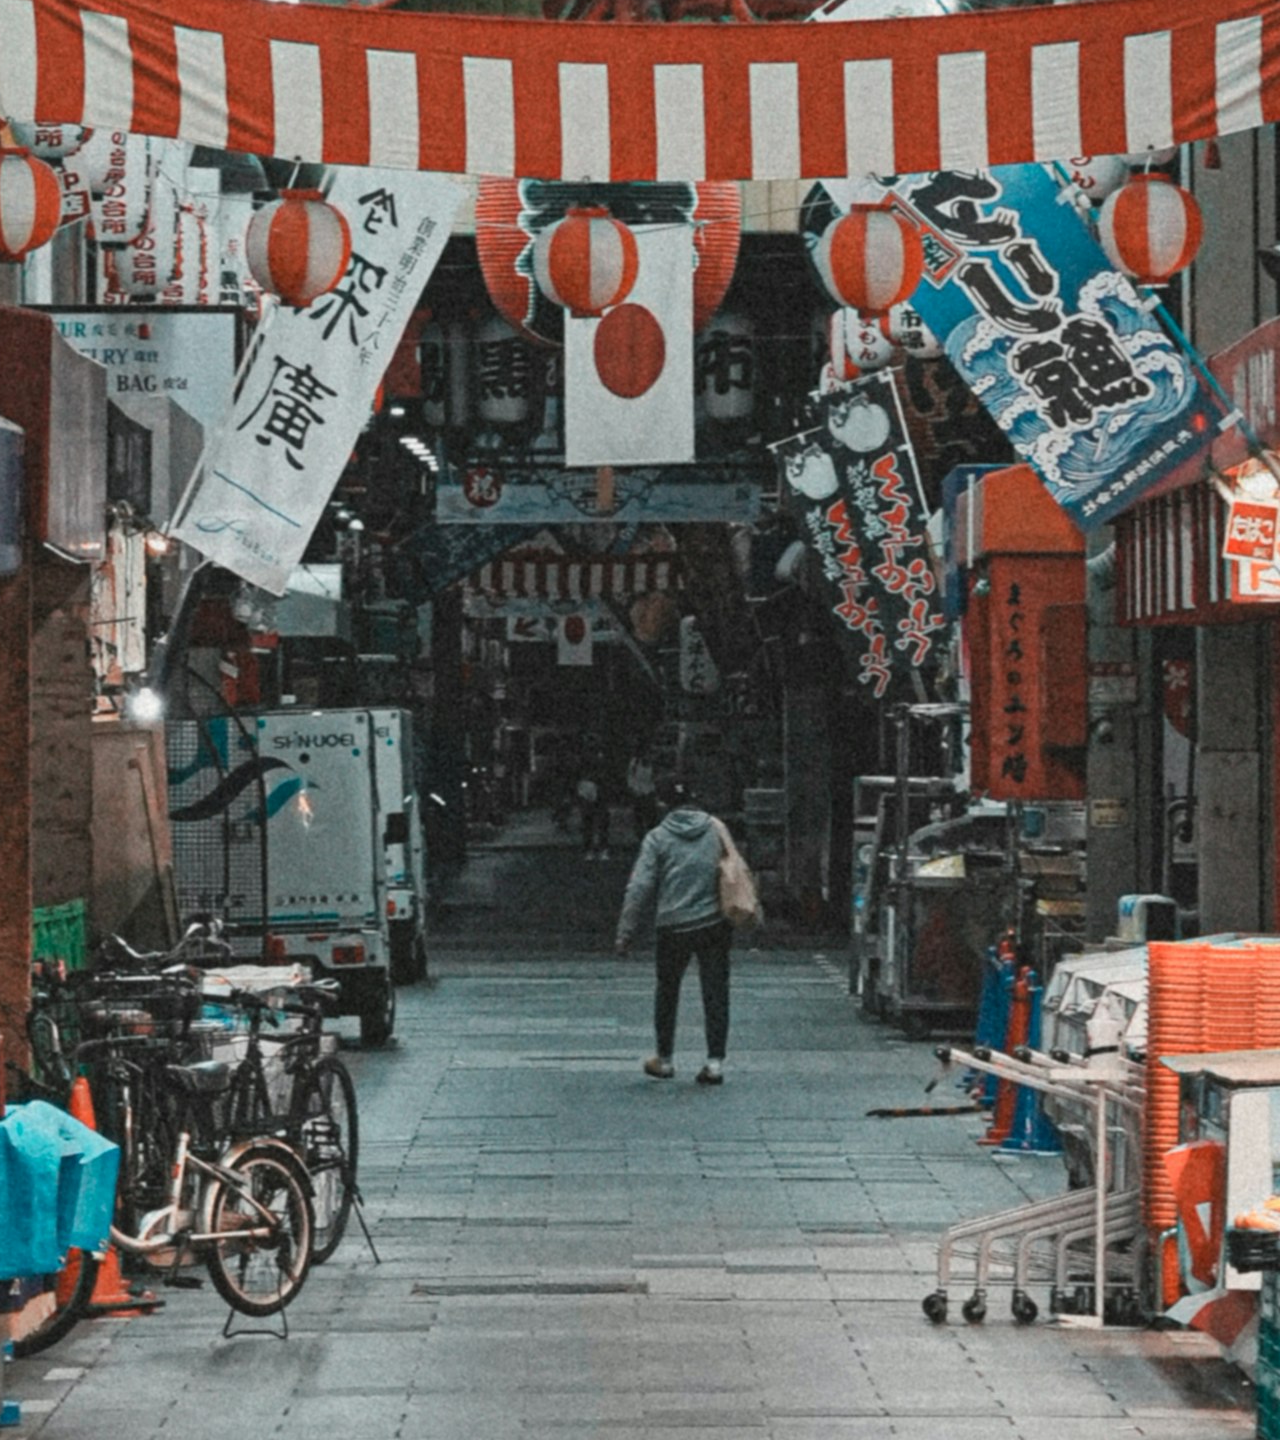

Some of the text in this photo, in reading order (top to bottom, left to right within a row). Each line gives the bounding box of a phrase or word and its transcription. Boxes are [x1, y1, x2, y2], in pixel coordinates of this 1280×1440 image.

[59, 322, 87, 338] UR
[116, 374, 157, 393] BAG
[1229, 514, 1276, 545] たばこ
